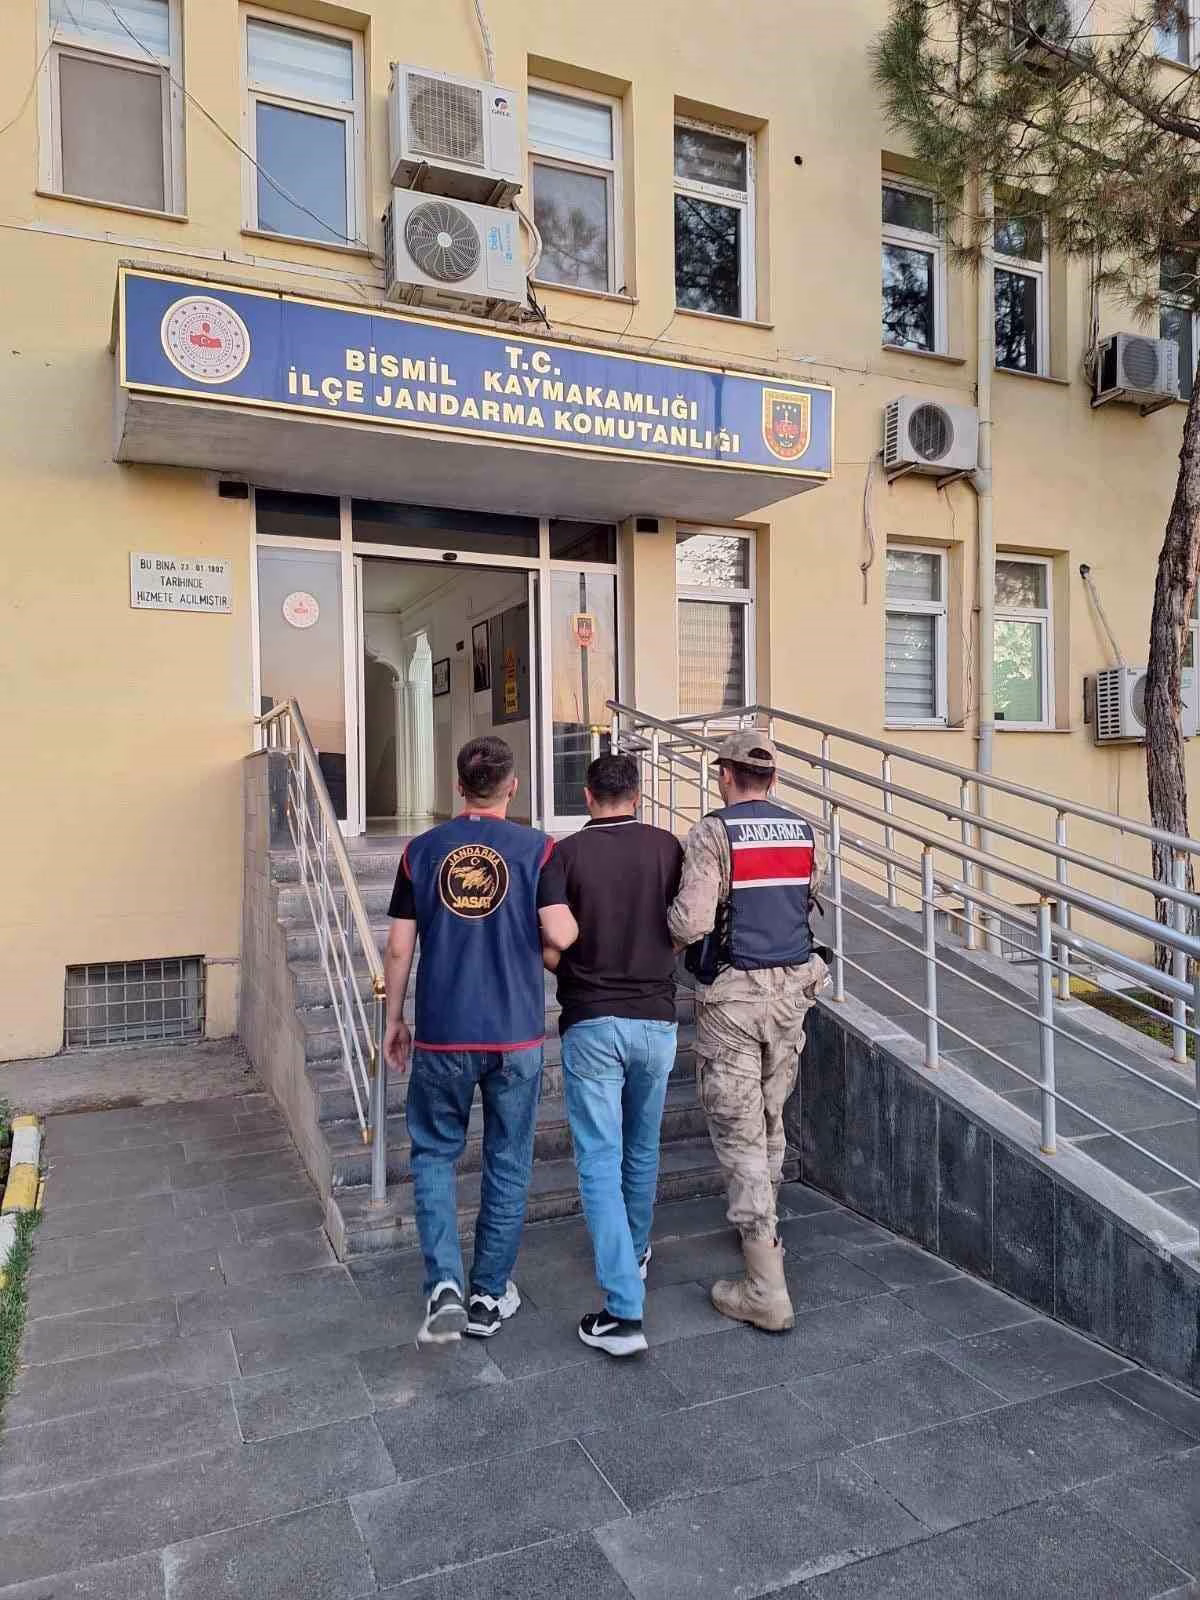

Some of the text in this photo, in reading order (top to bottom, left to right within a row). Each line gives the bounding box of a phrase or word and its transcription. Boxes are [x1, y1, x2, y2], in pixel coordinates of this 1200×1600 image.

[505, 346, 561, 376] T.C.
[345, 346, 698, 421] BİSMİL KAYMAKAMLIĞI
[288, 366, 740, 453] İLÇE JANDARMA KOMUTANLIĞI
[140, 558, 152, 570] BU
[738, 823, 806, 842] JANDARMA
[448, 847, 501, 867] JANDARMA
[452, 896, 494, 909] JASAT
